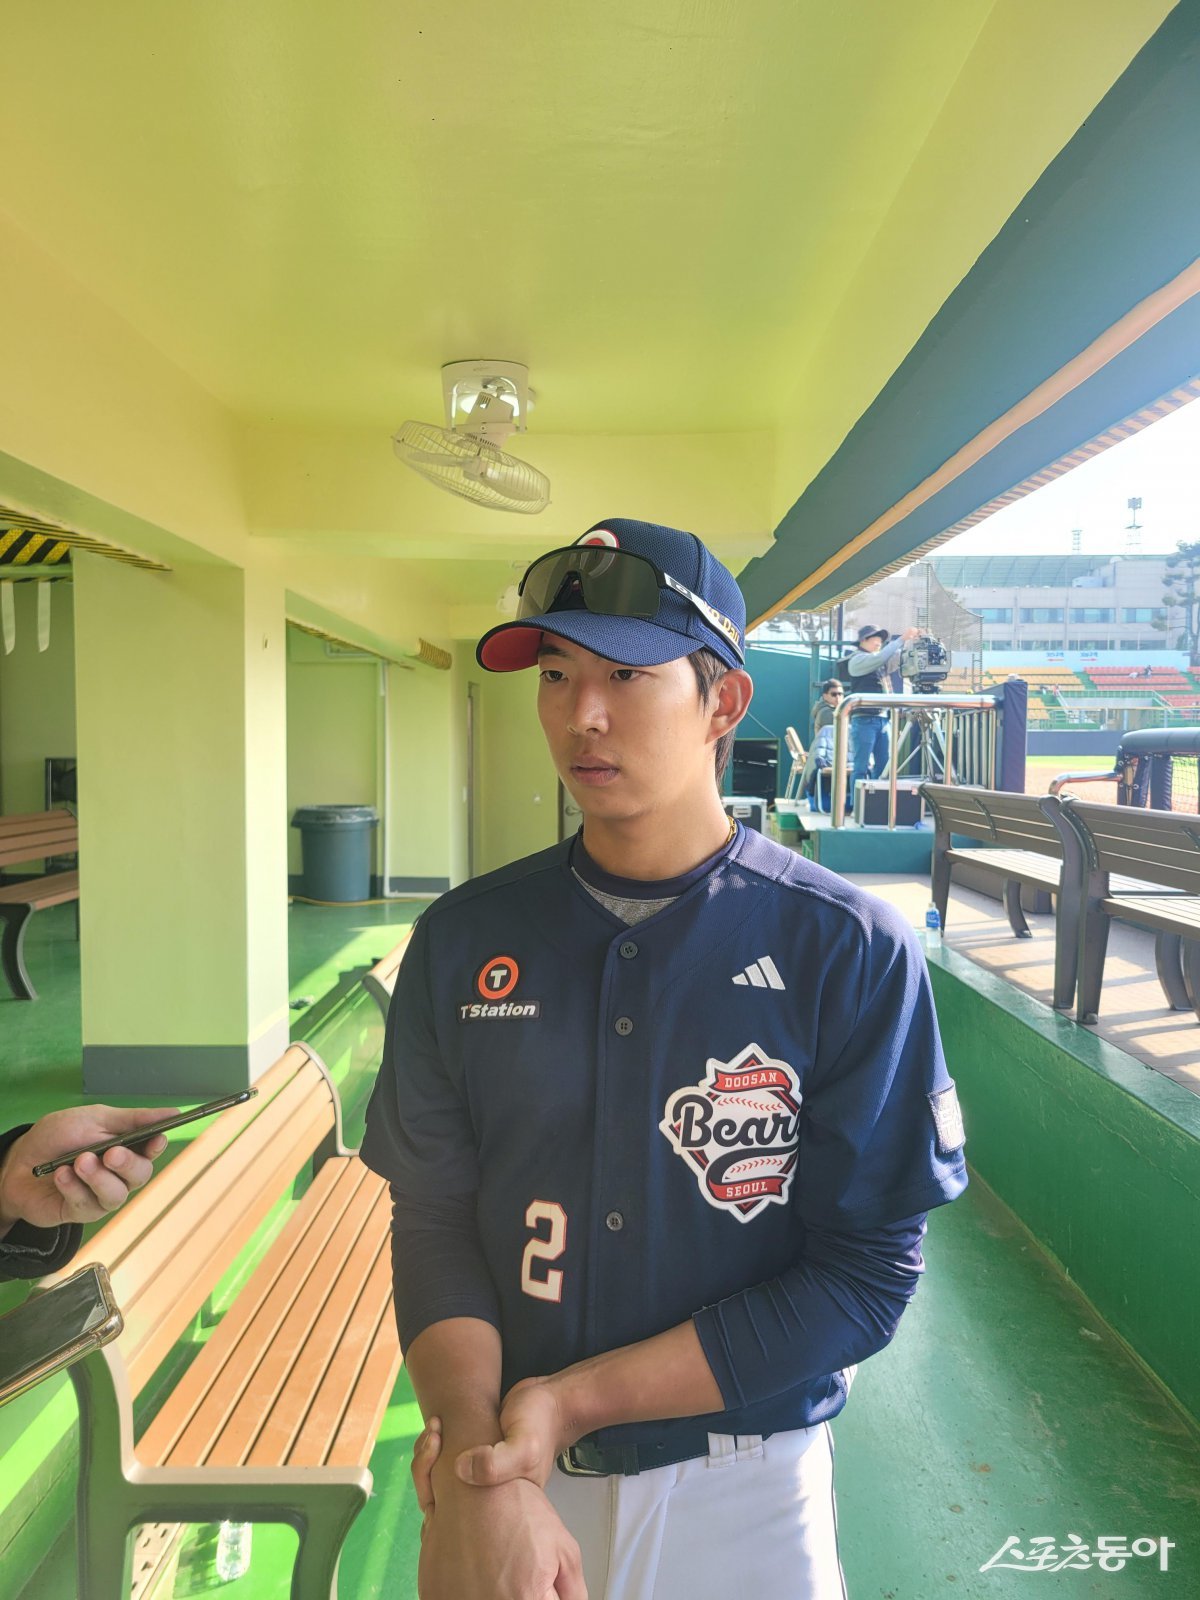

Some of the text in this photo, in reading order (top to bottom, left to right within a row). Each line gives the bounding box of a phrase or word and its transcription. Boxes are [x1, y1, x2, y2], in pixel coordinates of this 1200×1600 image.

[724, 1072, 777, 1088] DOOSAN
[726, 1181, 768, 1197] SEOUL
[521, 1199, 568, 1303] 2
